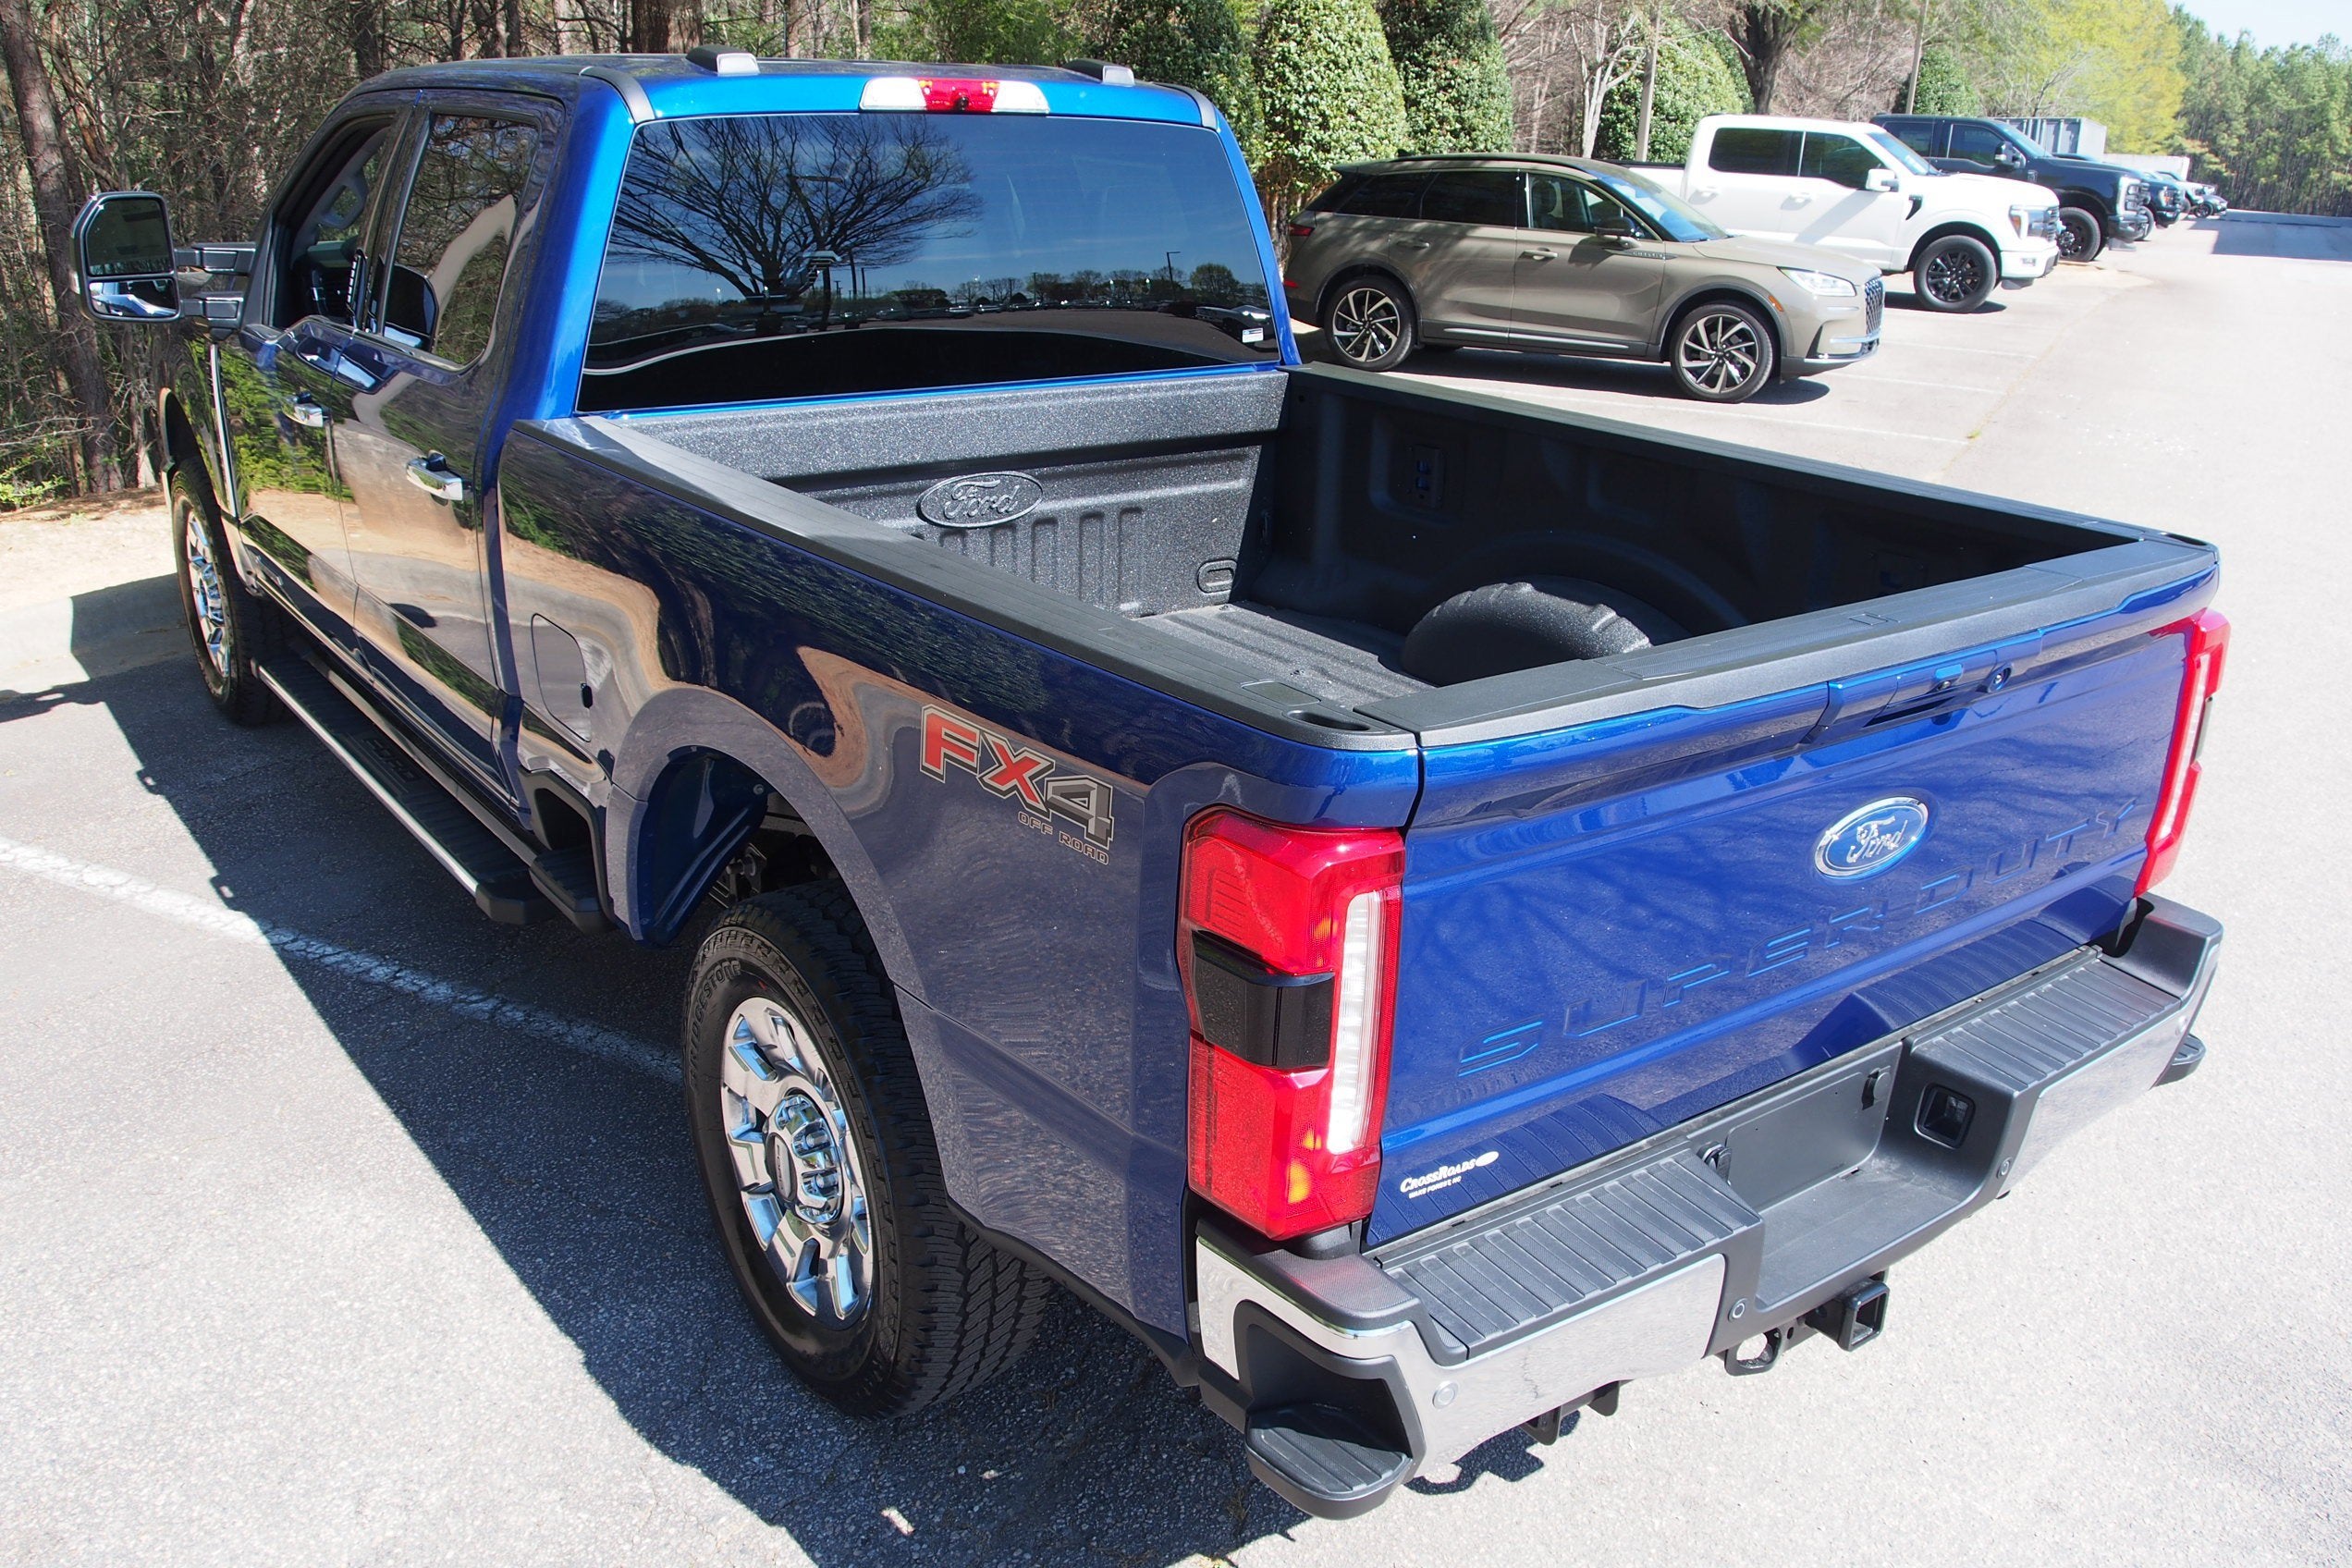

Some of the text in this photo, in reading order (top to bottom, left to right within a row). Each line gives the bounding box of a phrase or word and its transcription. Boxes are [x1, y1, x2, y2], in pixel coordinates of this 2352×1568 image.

[944, 479, 1021, 520] Ford
[920, 704, 1113, 850] FX4
[1018, 811, 1109, 865] OFF ROAD
[1846, 815, 1908, 863] Ford
[1457, 797, 2138, 1078] SUPER DUTY
